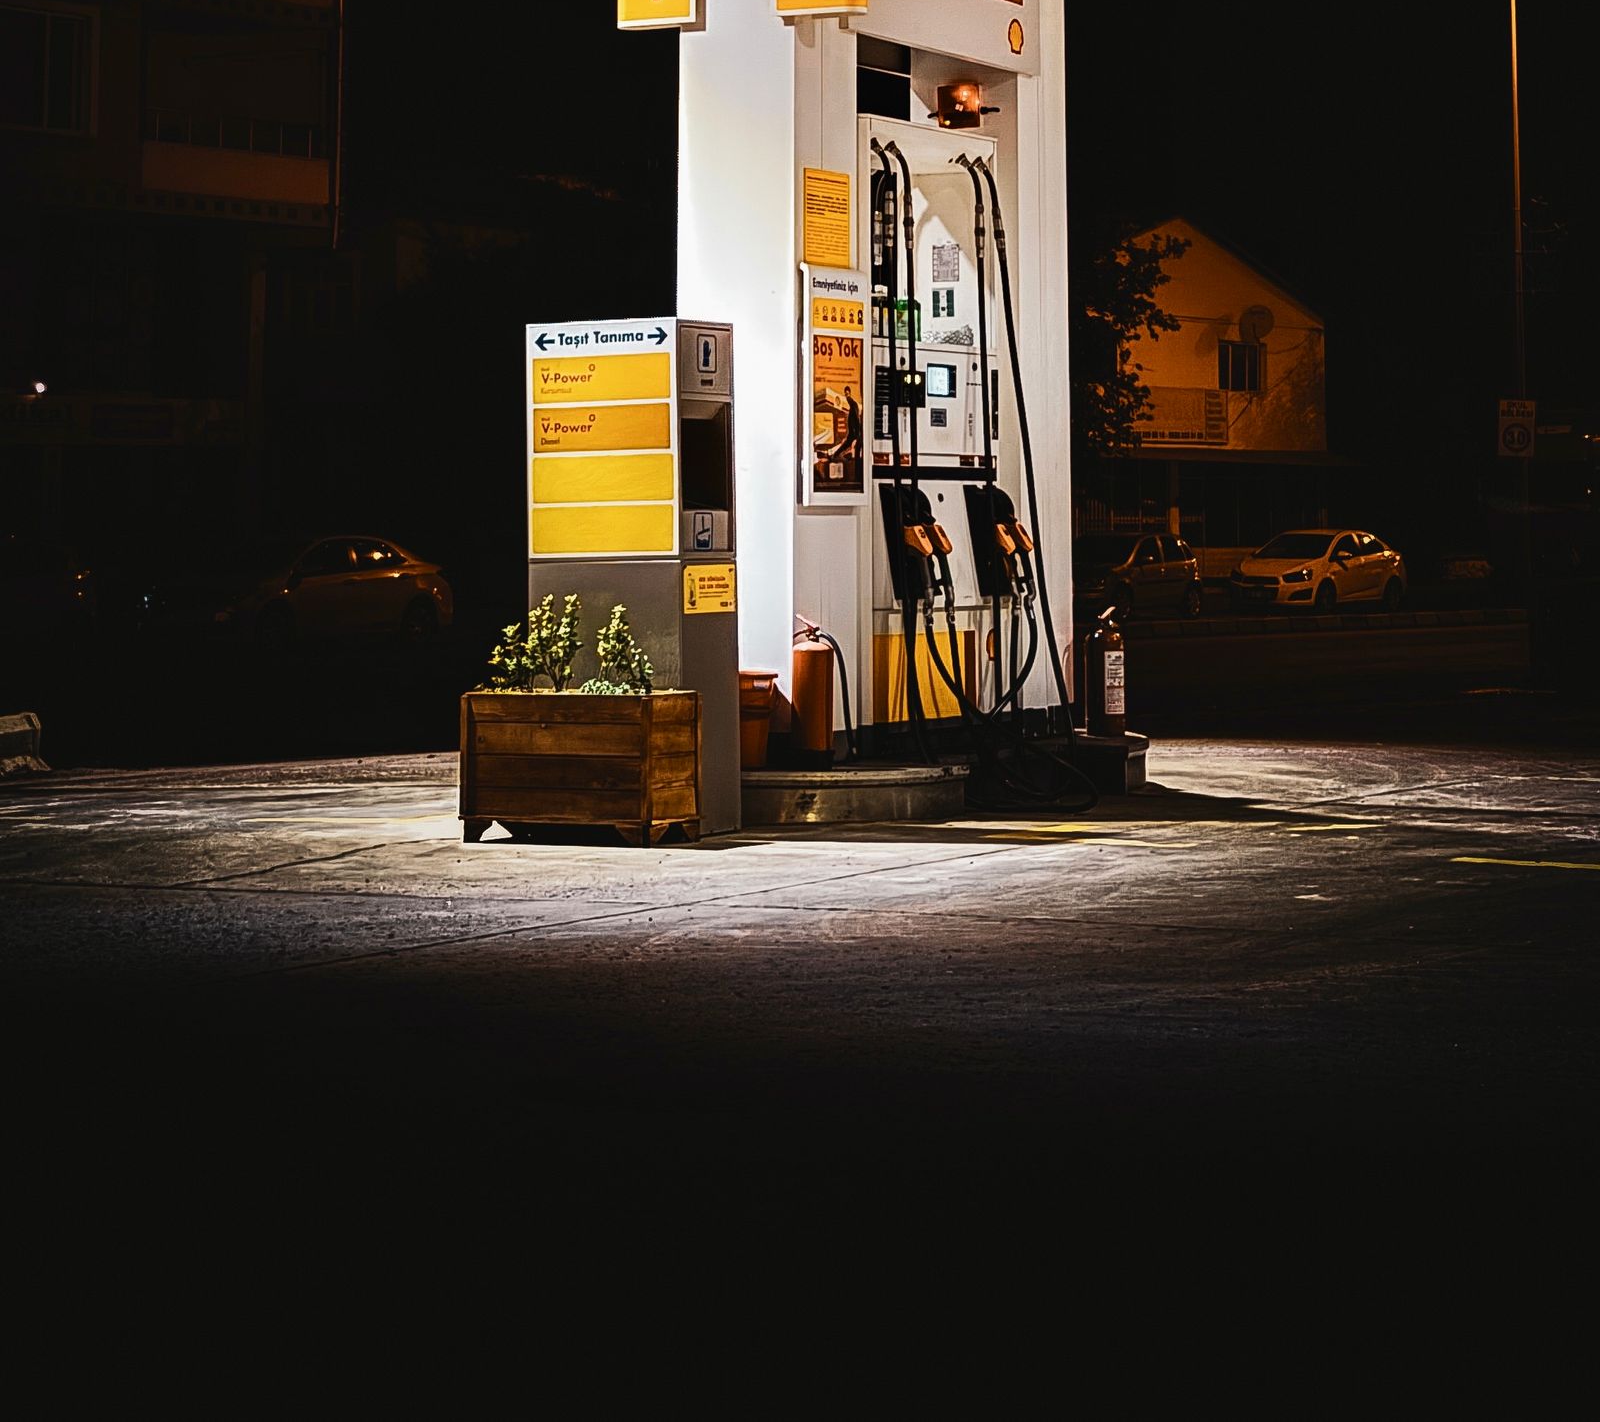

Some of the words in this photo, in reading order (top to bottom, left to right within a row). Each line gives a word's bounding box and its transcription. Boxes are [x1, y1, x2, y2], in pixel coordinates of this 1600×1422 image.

[557, 332, 590, 349] Taşıt
[593, 330, 644, 345] Tanıma
[835, 337, 859, 358] Yok
[541, 372, 593, 384] V-Power
[541, 422, 593, 434] V-Power
[1507, 430, 1525, 445] 30
